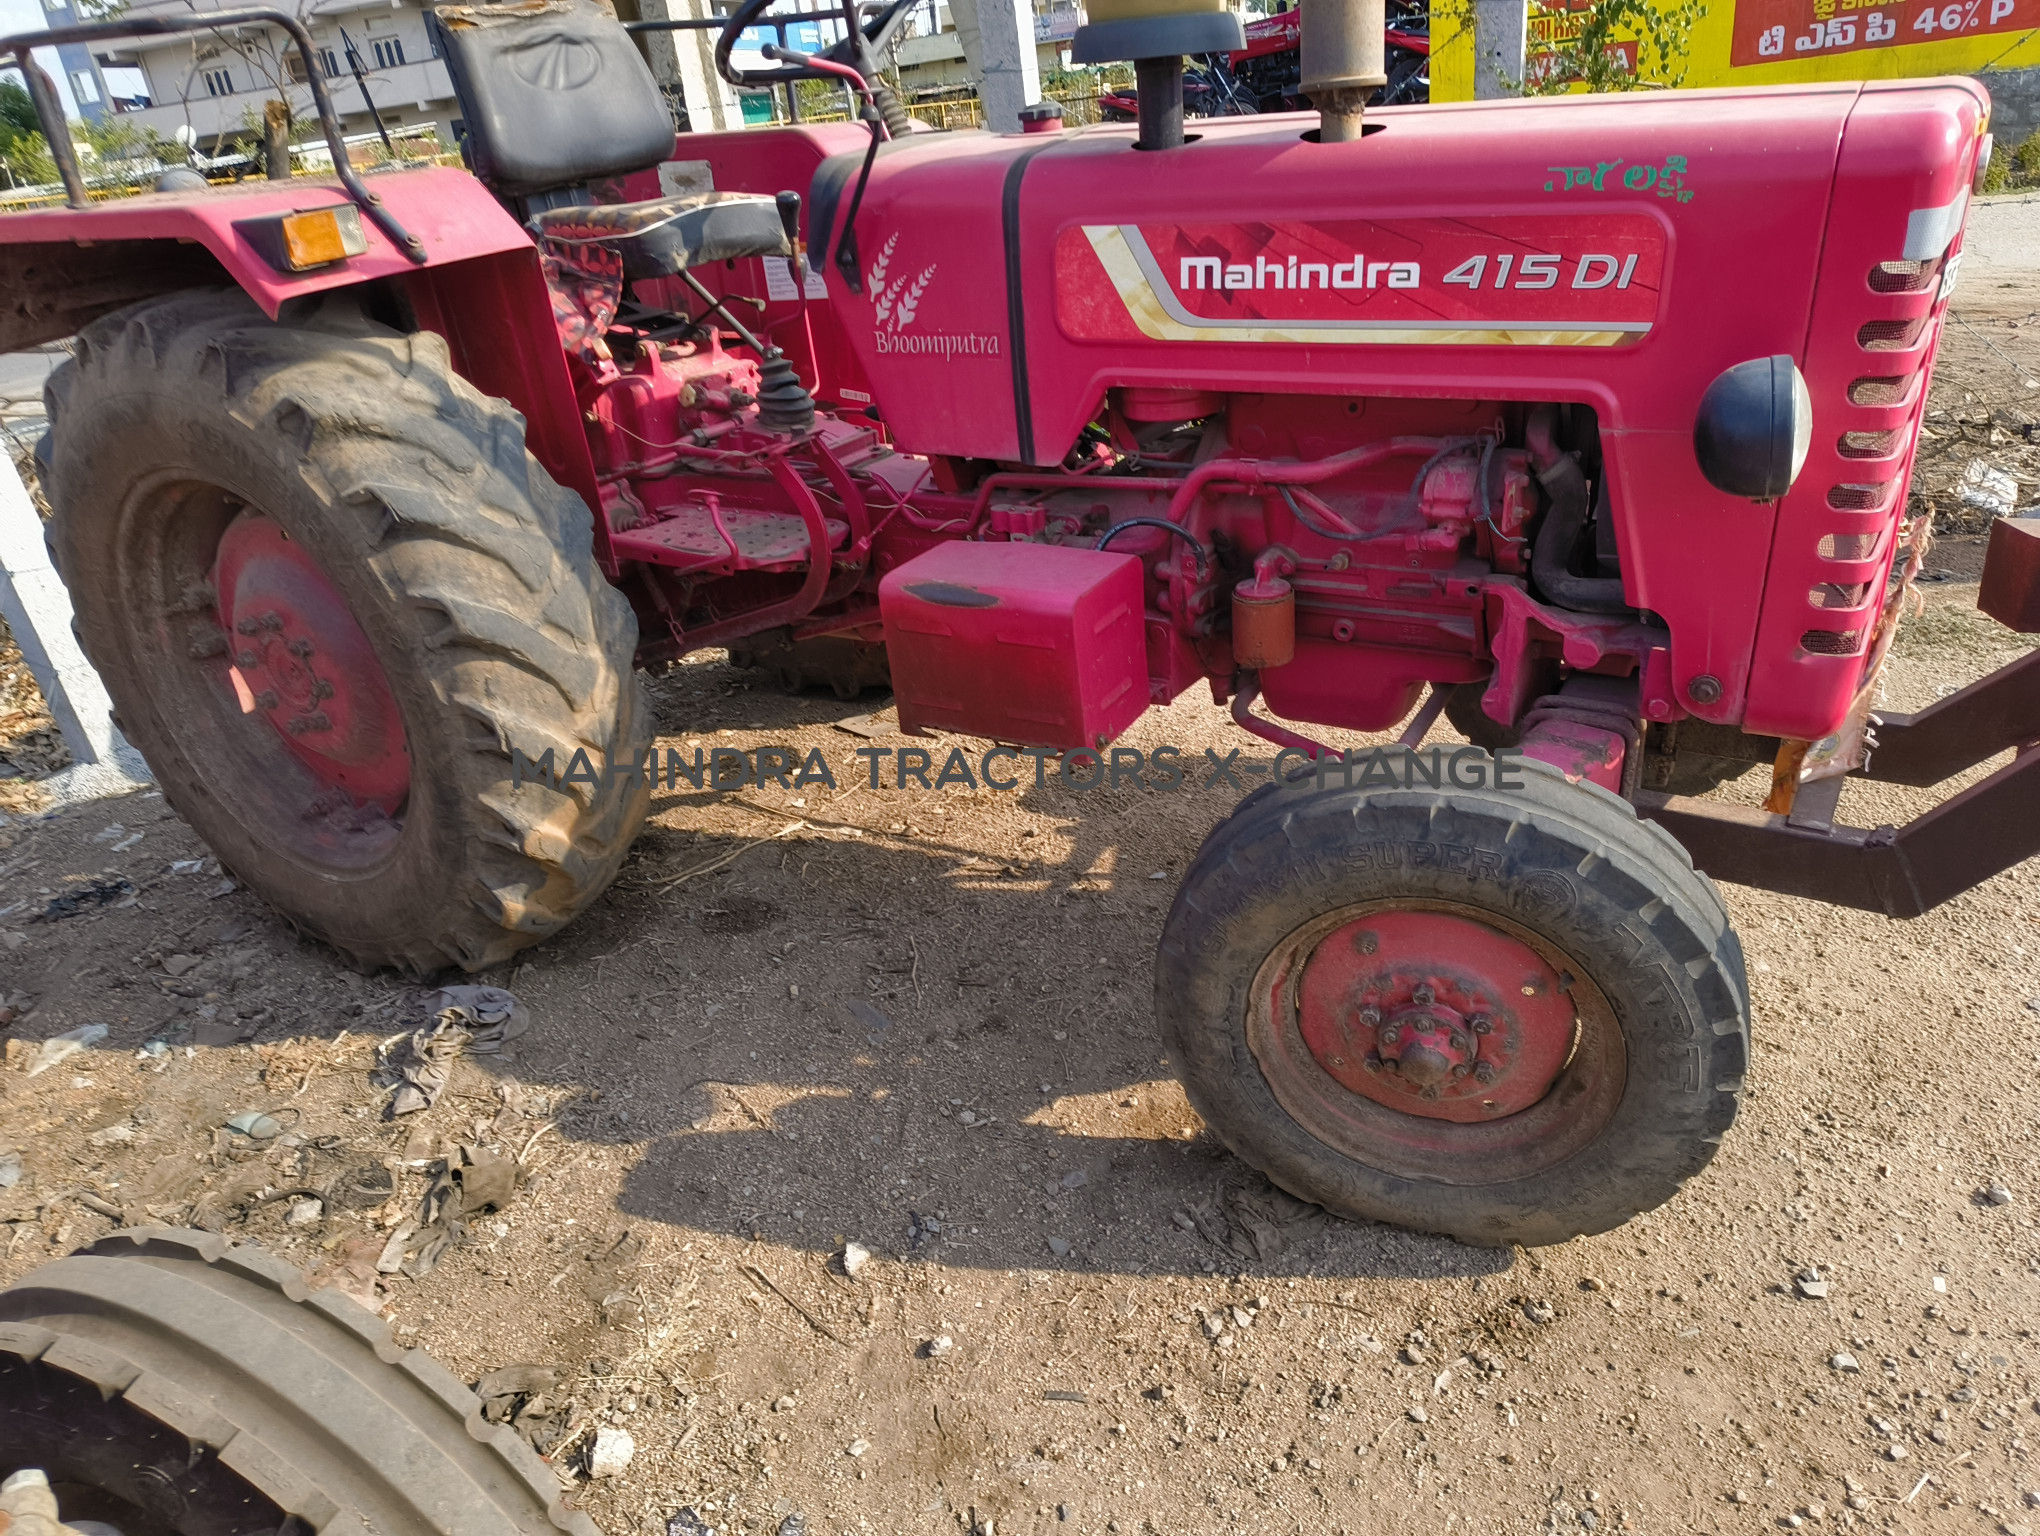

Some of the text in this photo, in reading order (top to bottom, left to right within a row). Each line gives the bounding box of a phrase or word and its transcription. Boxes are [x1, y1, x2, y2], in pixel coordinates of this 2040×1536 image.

[1913, 0, 1982, 34] 46%
[1180, 253, 1640, 290] Mahindra 415 DI
[873, 328, 1000, 362] Bhoomiputra
[1343, 840, 1506, 883] SUPER
